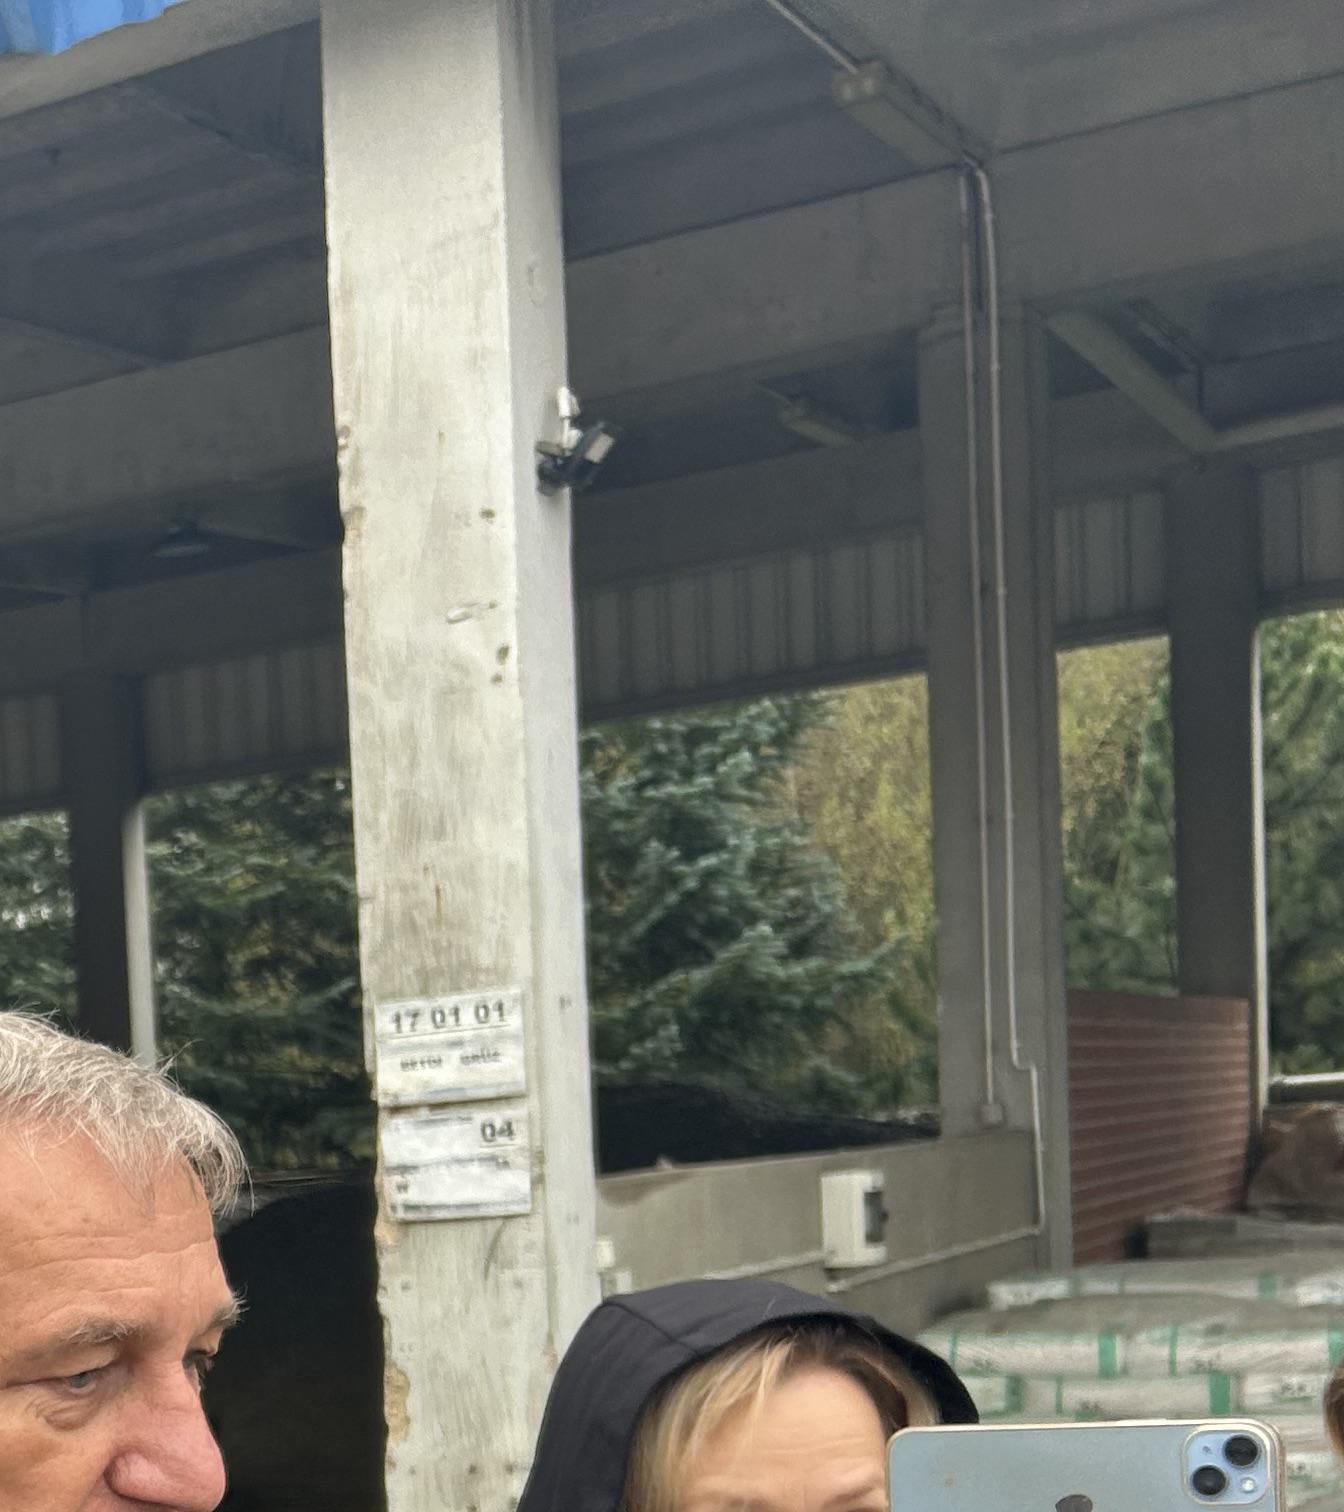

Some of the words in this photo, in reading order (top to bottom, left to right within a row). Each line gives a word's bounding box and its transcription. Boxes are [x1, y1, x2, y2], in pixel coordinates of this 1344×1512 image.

[392, 1009, 421, 1034] 17
[431, 1005, 461, 1029] 01
[474, 1000, 505, 1024] 01
[480, 1119, 515, 1143] 04
